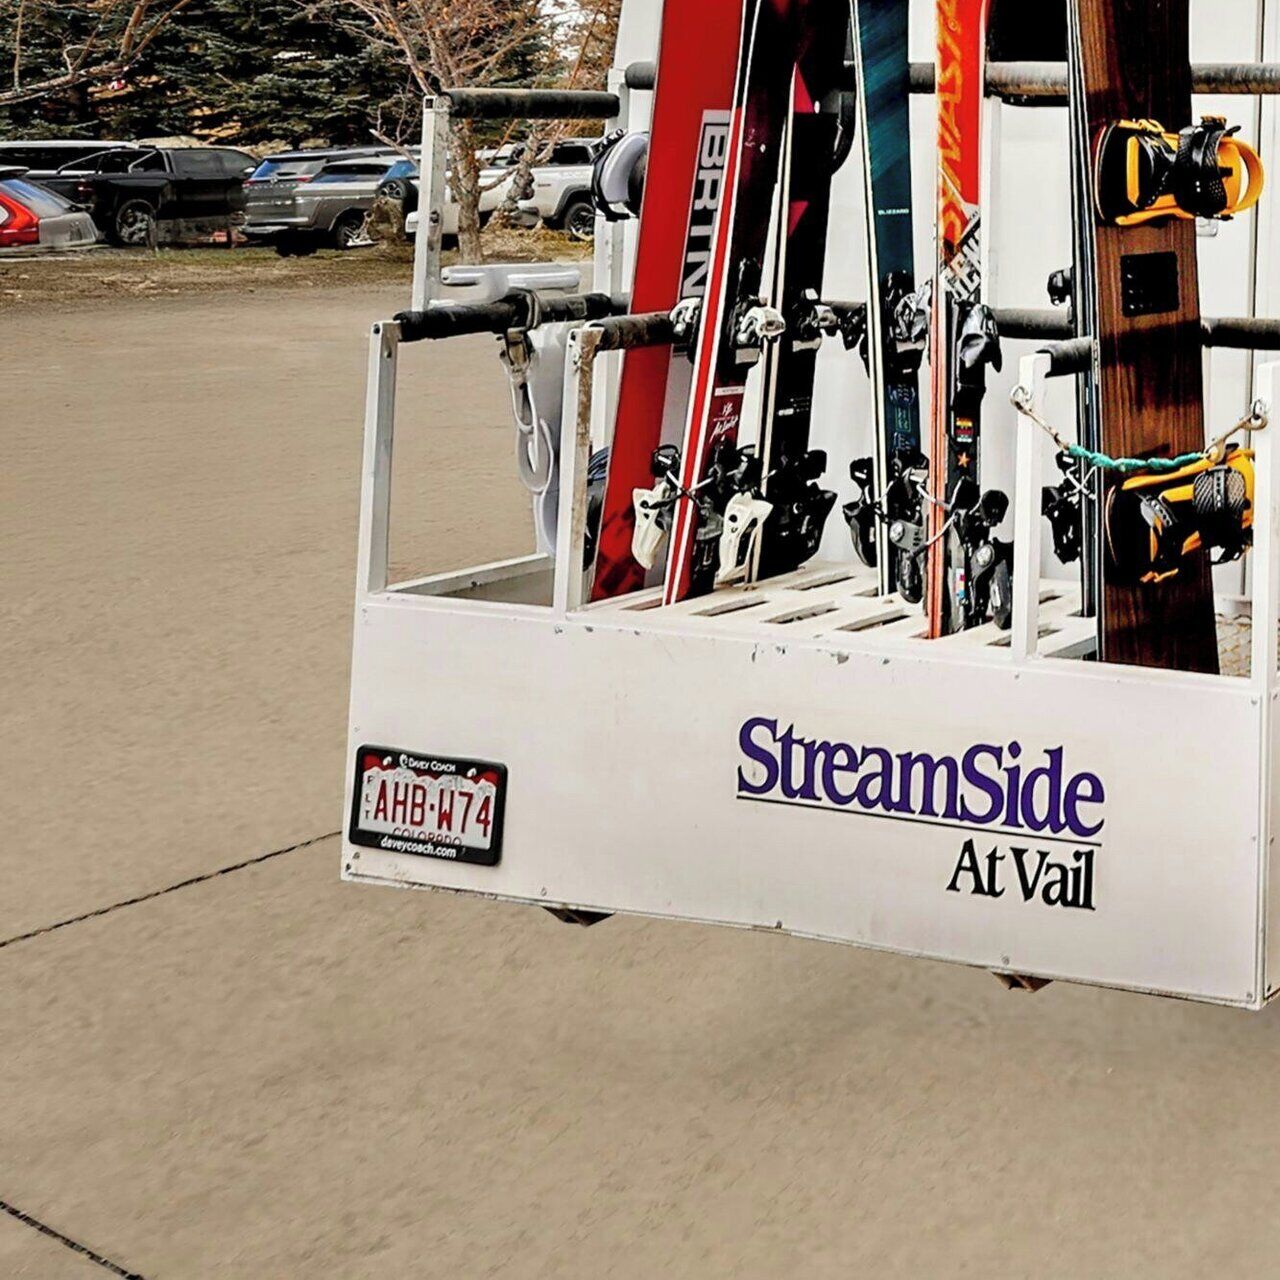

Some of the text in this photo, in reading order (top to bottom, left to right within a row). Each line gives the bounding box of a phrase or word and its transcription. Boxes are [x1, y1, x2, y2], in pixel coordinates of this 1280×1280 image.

[408, 758, 456, 773] DAVEY COACH
[737, 716, 1106, 838] StreamSide
[380, 836, 457, 859] daveycoach.com
[945, 837, 1097, 911] At Vail
